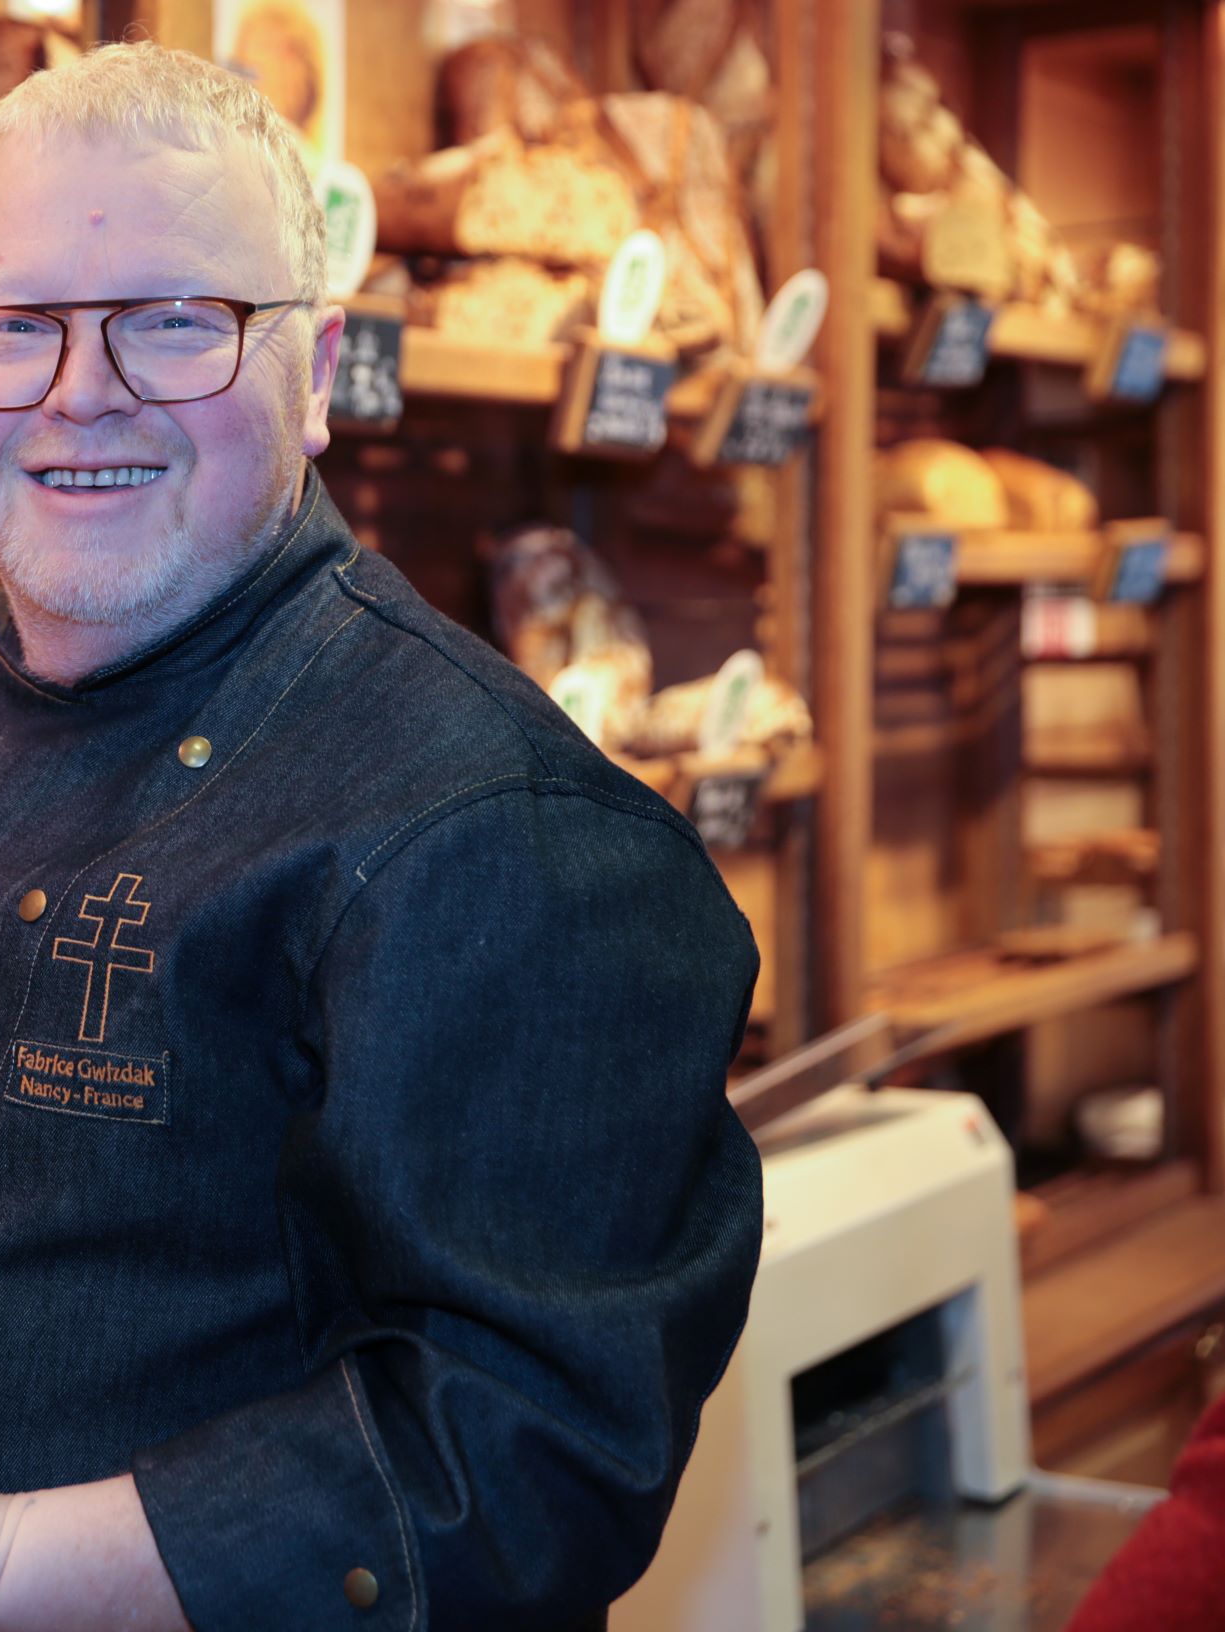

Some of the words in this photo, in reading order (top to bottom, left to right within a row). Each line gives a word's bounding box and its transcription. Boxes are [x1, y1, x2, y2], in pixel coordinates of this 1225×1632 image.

[17, 1045, 75, 1077] Fabrice
[77, 1058, 156, 1087] Gwizdak
[19, 1074, 72, 1105] Nancy
[83, 1085, 145, 1109] France
